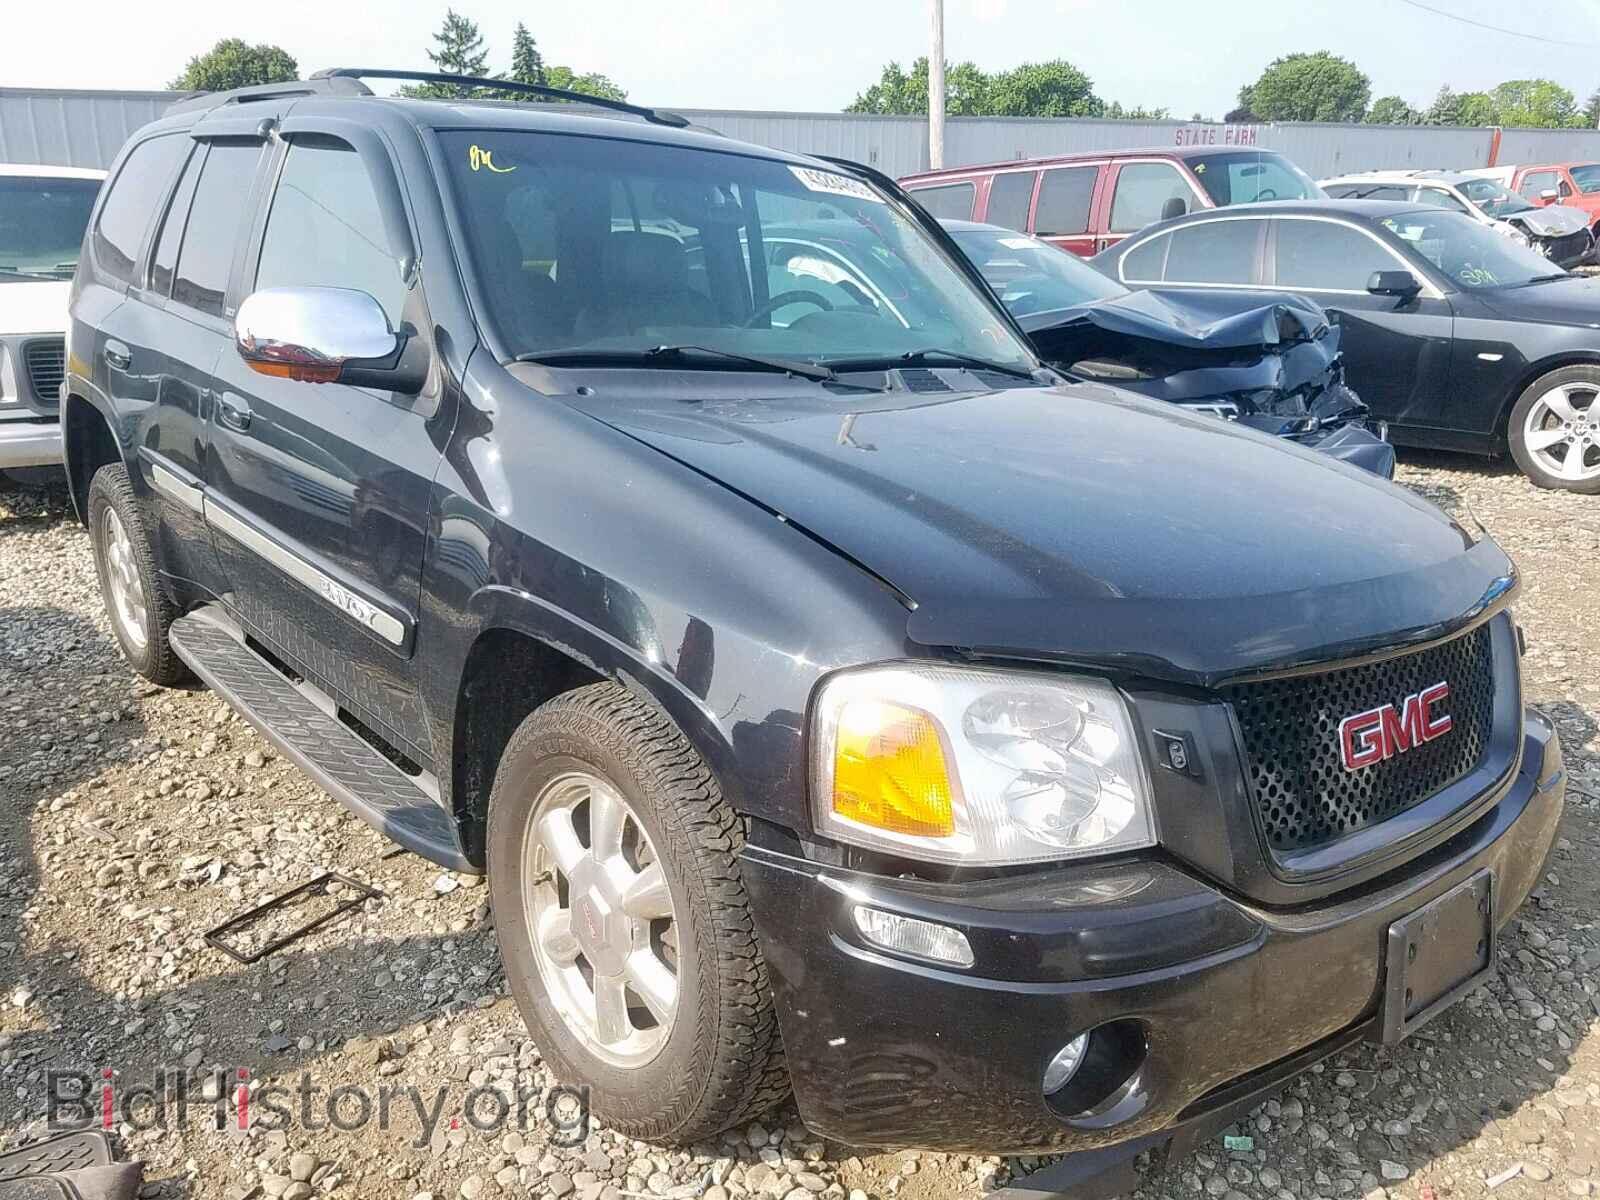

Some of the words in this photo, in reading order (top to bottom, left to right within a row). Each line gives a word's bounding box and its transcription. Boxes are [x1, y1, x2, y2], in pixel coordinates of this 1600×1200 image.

[1175, 128, 1216, 146] STATE
[1225, 127, 1257, 145] FARM
[1338, 681, 1452, 772] GMC
